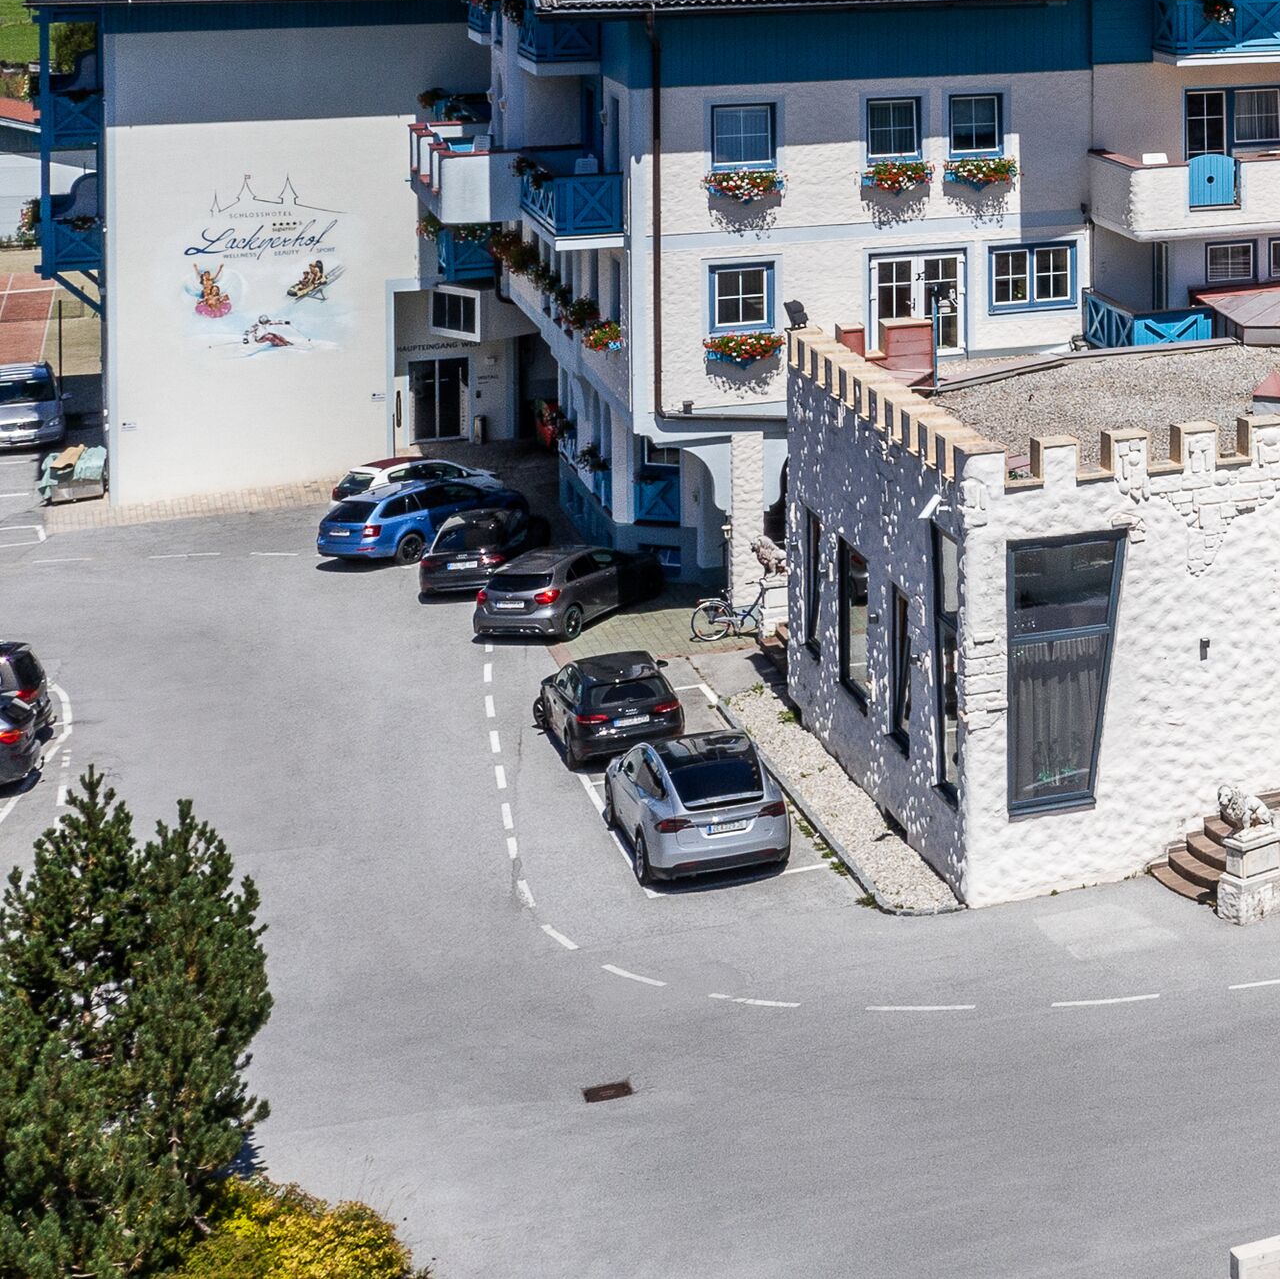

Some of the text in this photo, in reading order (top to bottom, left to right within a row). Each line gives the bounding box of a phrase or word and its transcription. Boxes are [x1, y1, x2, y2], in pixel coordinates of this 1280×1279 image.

[229, 210, 293, 219] SCHLOSSHOTEL
[184, 219, 338, 261] Lacknerhof
[273, 249, 300, 257] BEAUTY
[396, 341, 458, 353] HAUPTEINGANG
